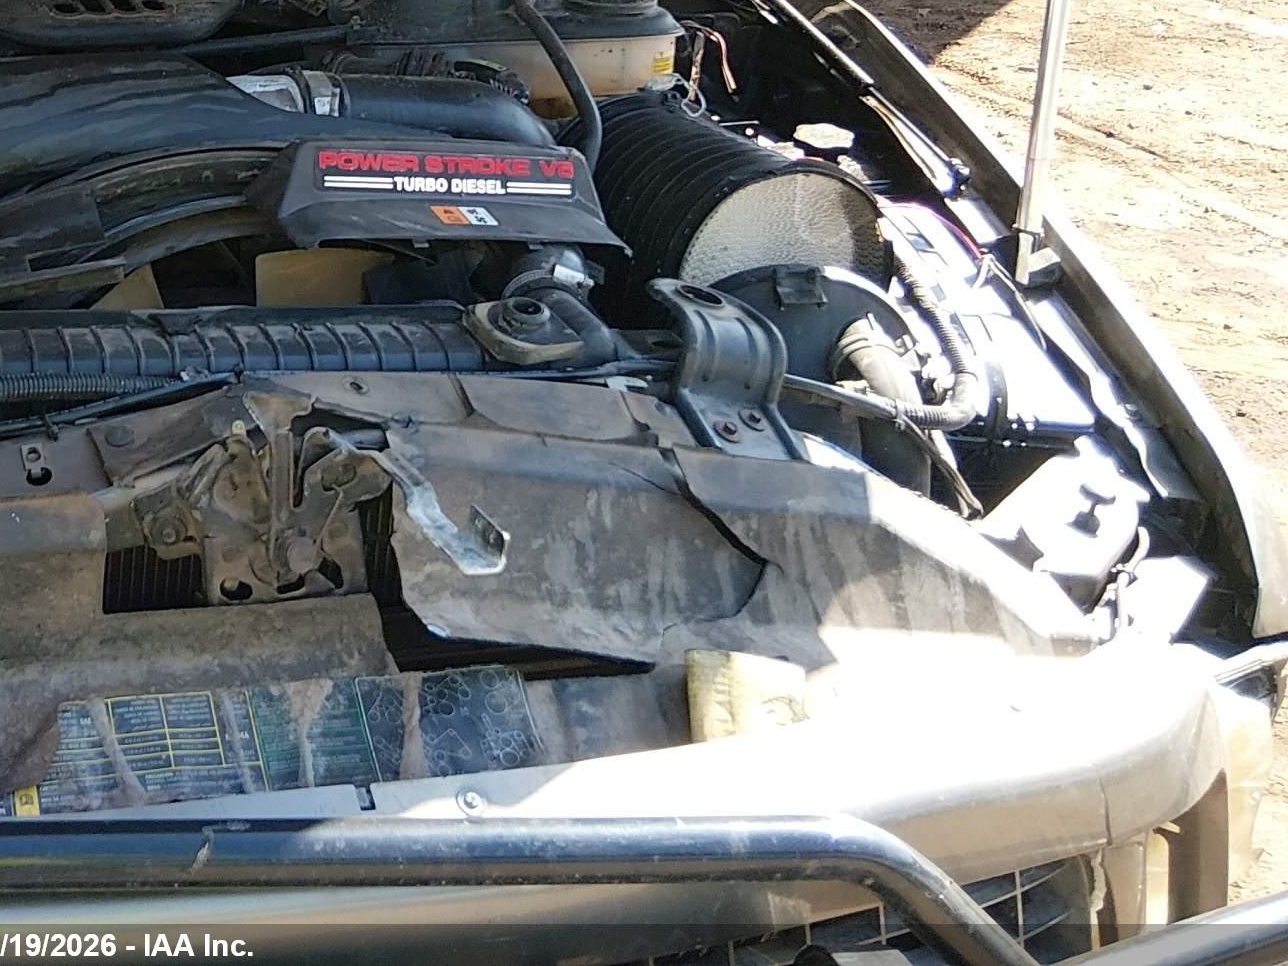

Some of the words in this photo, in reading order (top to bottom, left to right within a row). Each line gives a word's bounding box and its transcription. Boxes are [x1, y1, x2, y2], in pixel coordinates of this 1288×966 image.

[317, 150, 420, 173] POWER
[423, 155, 531, 176] STROKE
[393, 176, 449, 193] TURBO
[450, 177, 506, 195] DIESEL
